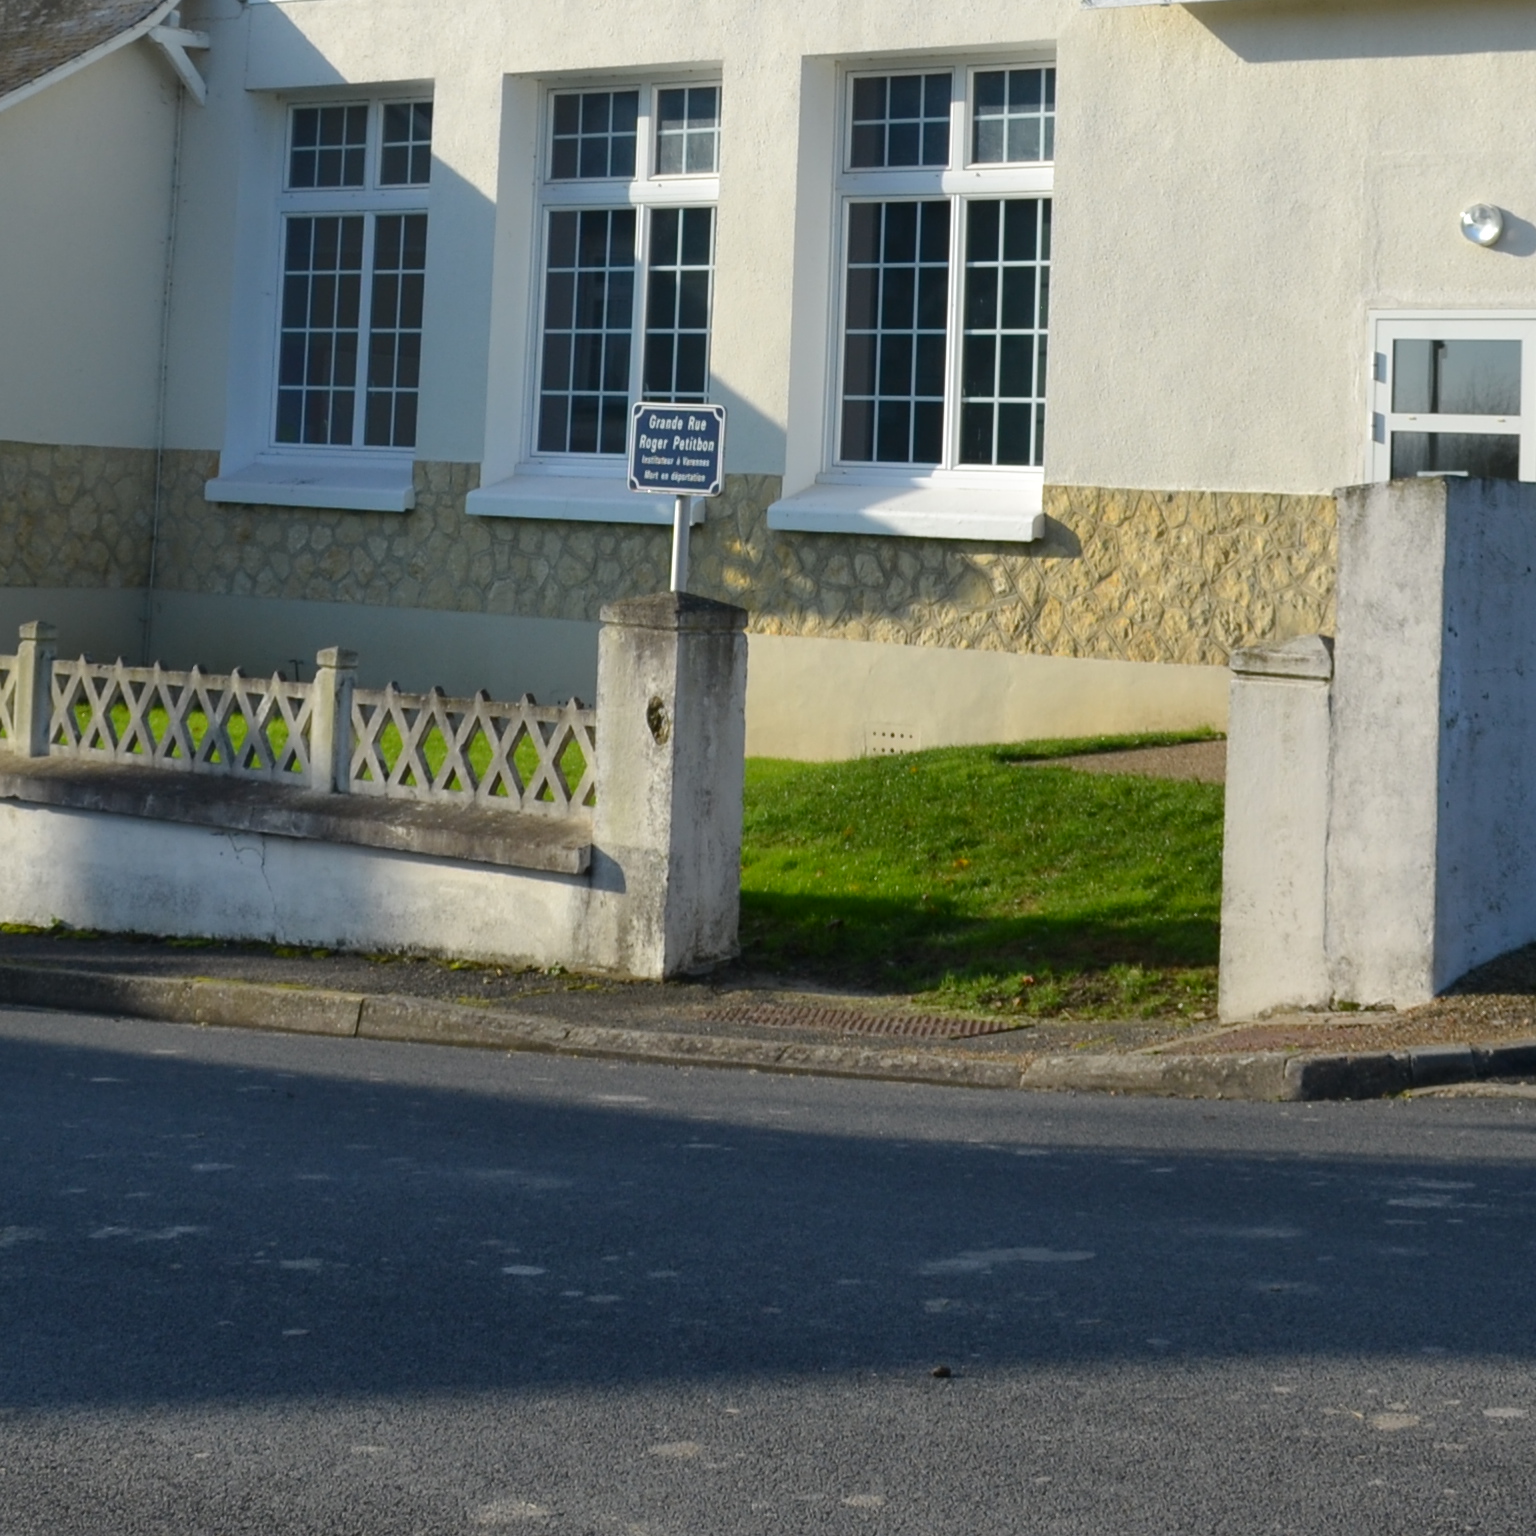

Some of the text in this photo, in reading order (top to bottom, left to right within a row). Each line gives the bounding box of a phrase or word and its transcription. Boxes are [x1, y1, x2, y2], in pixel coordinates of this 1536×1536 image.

[649, 414, 707, 431] Grande Rue
[639, 434, 715, 453] Roger Petitbon
[641, 454, 674, 465] Instituteur
[682, 456, 710, 467] Varennes
[644, 469, 706, 483] Mort en déportation
